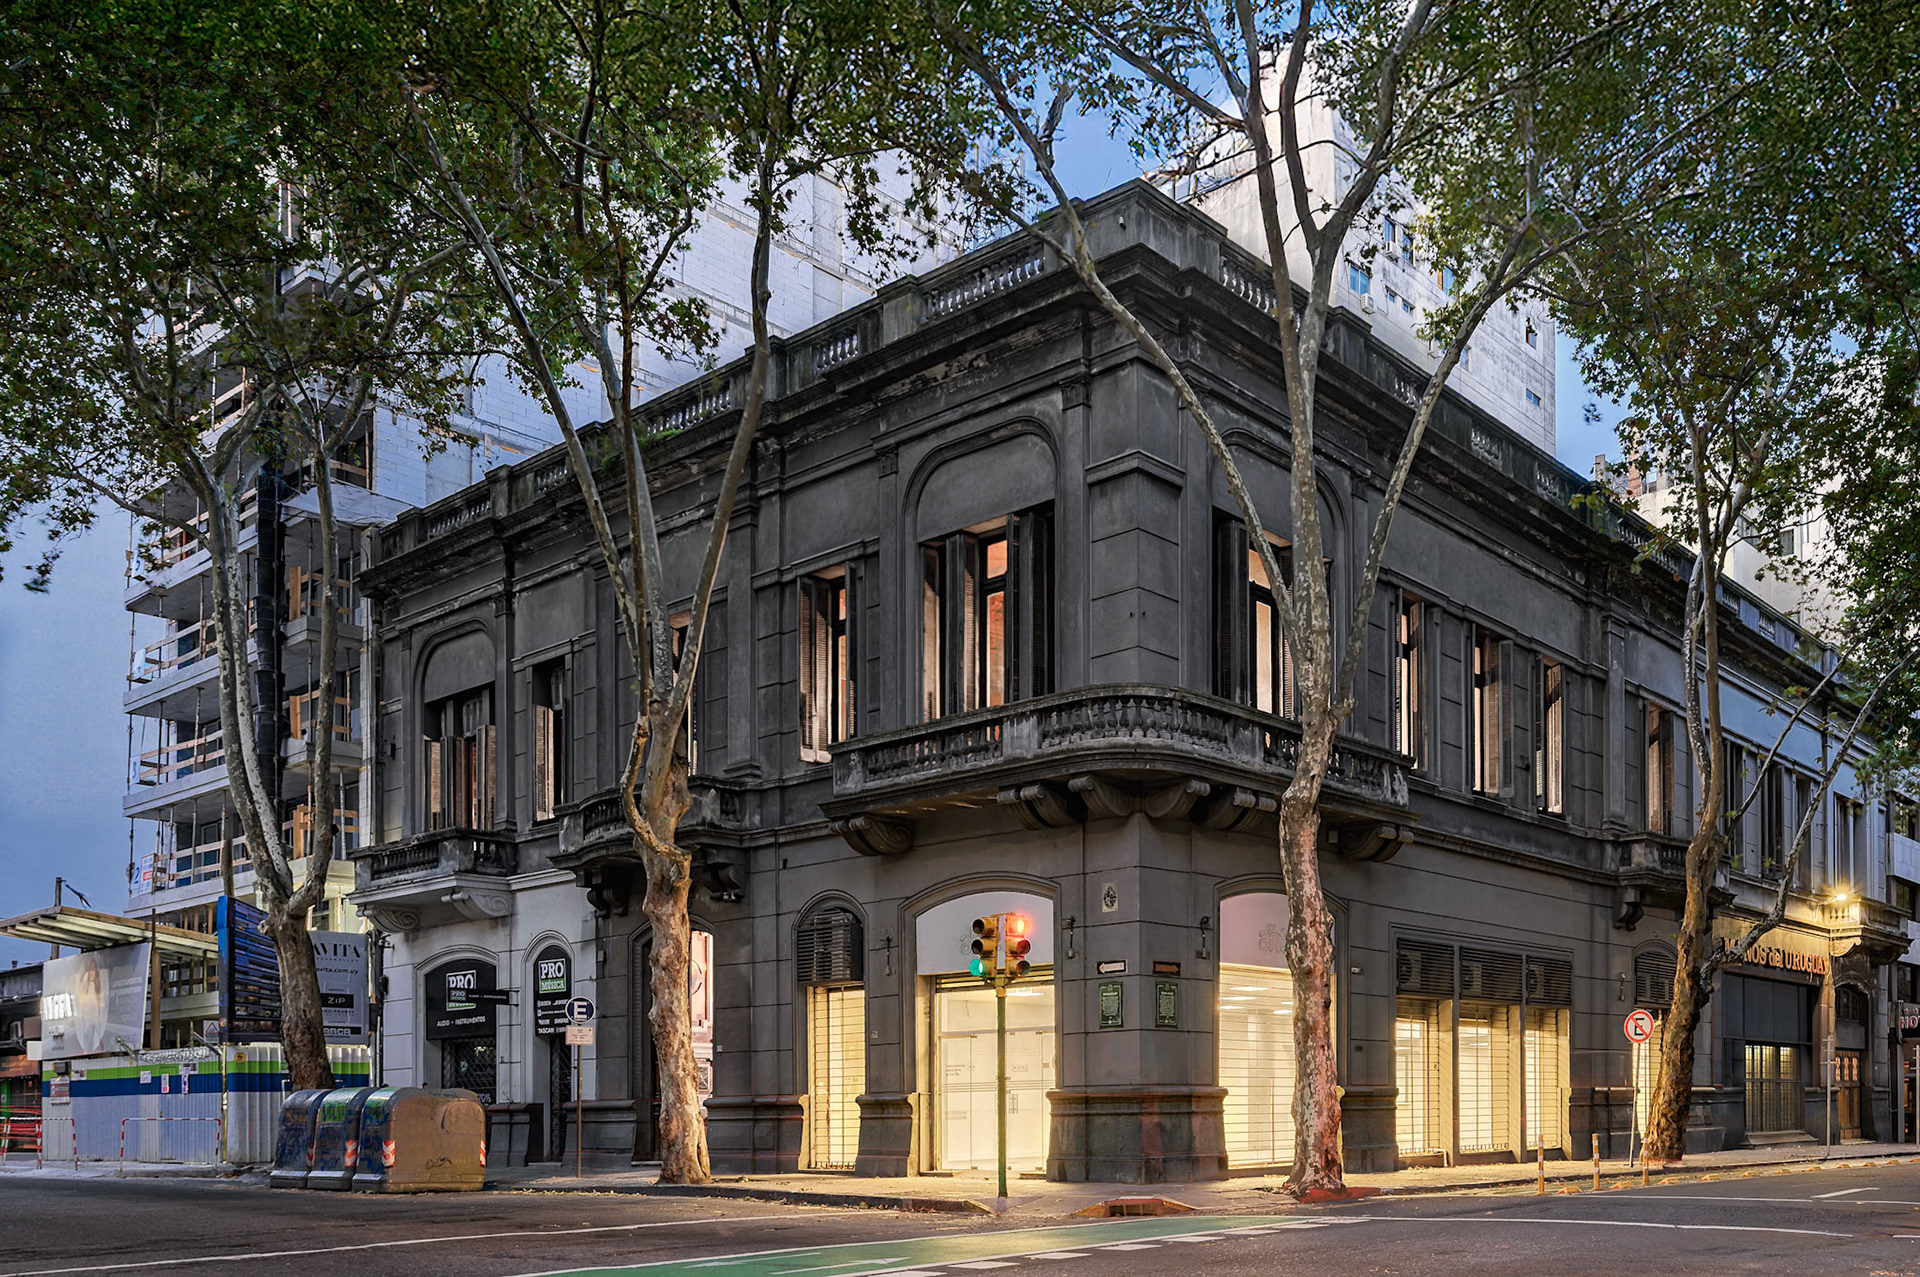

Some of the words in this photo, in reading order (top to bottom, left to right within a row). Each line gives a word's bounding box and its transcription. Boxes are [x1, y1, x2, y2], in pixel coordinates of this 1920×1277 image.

[1724, 937, 1768, 966] MNOS
[1784, 949, 1830, 976] URUGUAY
[540, 962, 564, 980] PRO
[541, 979, 565, 991] MÚSICA
[327, 996, 346, 1005] ZIP
[573, 1001, 588, 1019] E
[437, 1019, 450, 1028] AUDIO
[454, 1015, 486, 1026] INSTRUMENTOS
